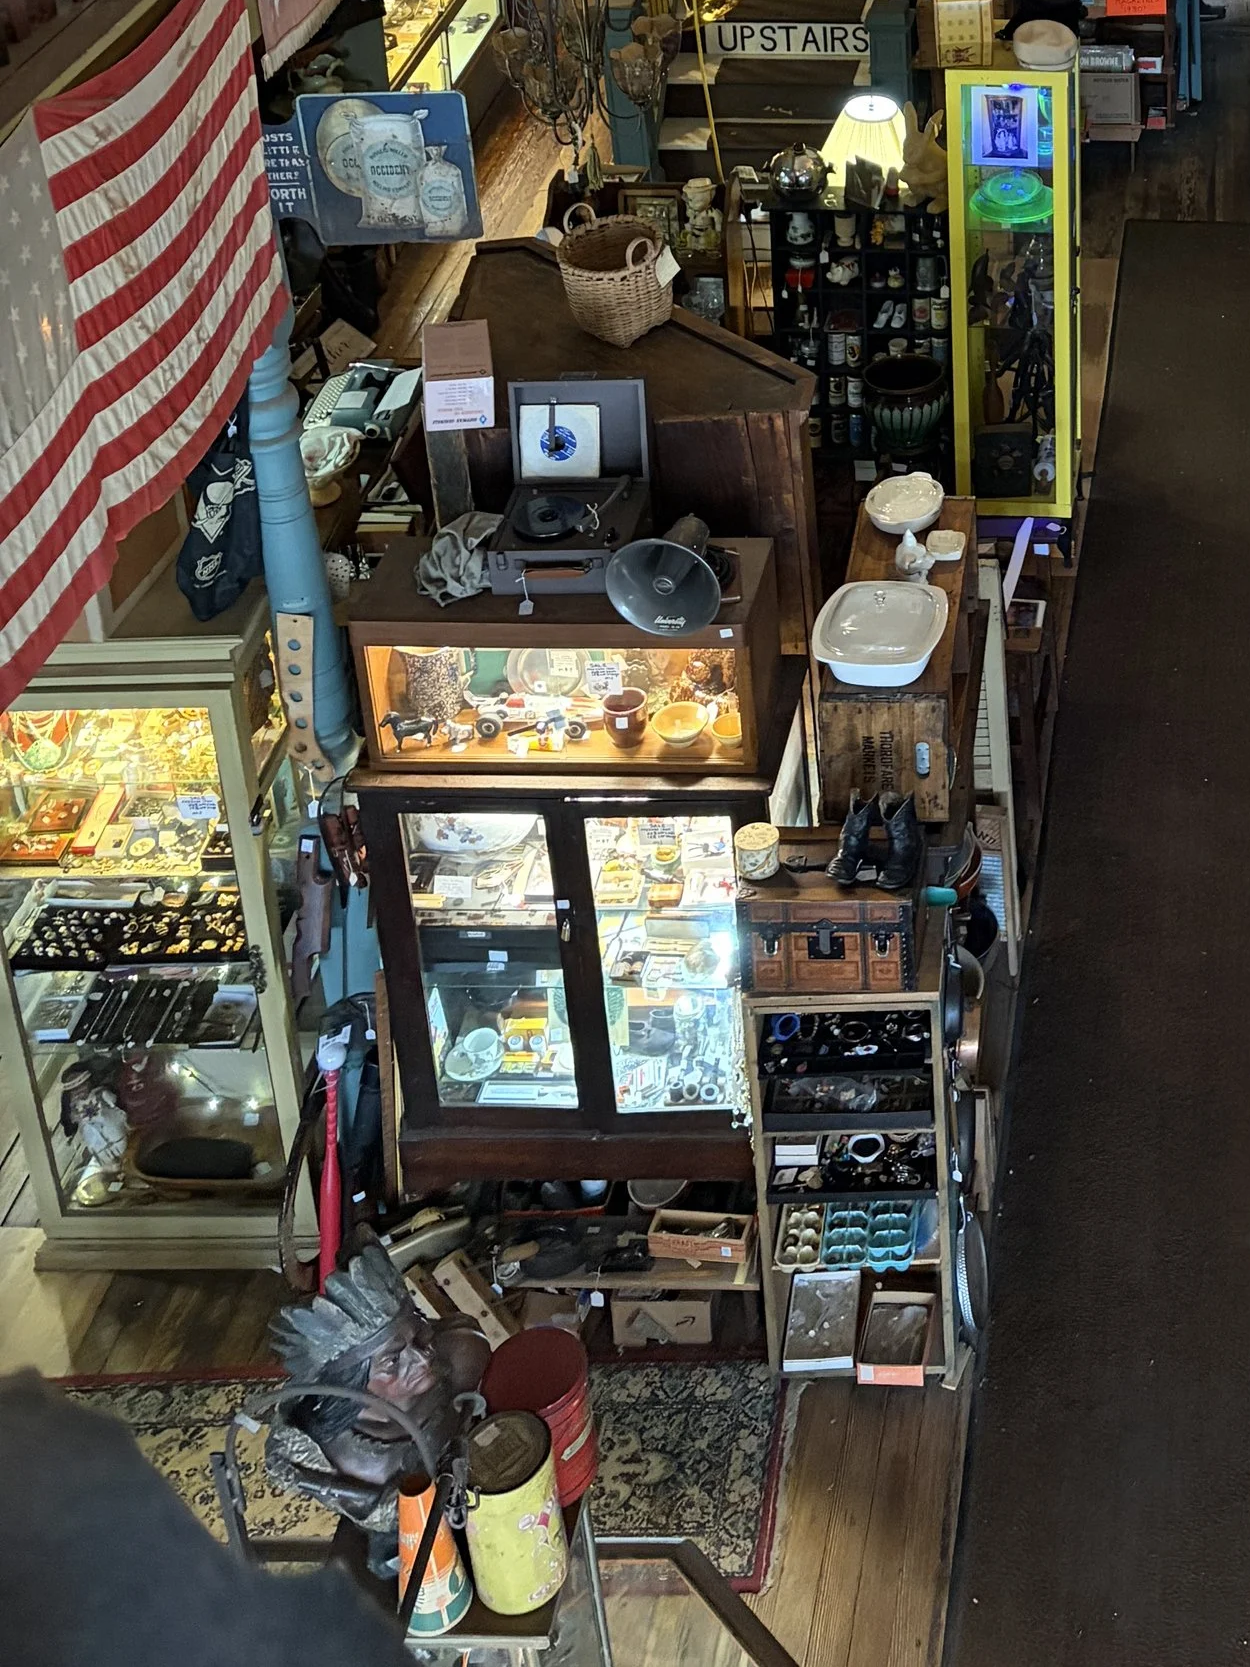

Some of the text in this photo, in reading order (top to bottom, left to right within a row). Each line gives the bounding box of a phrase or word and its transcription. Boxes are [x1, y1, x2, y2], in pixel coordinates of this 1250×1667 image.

[717, 25, 870, 53] UPSTAIRS
[1090, 56, 1119, 66] BROWNE
[370, 164, 411, 176] OCCIDENT
[270, 188, 307, 200] ORTH
[278, 202, 294, 213] IT
